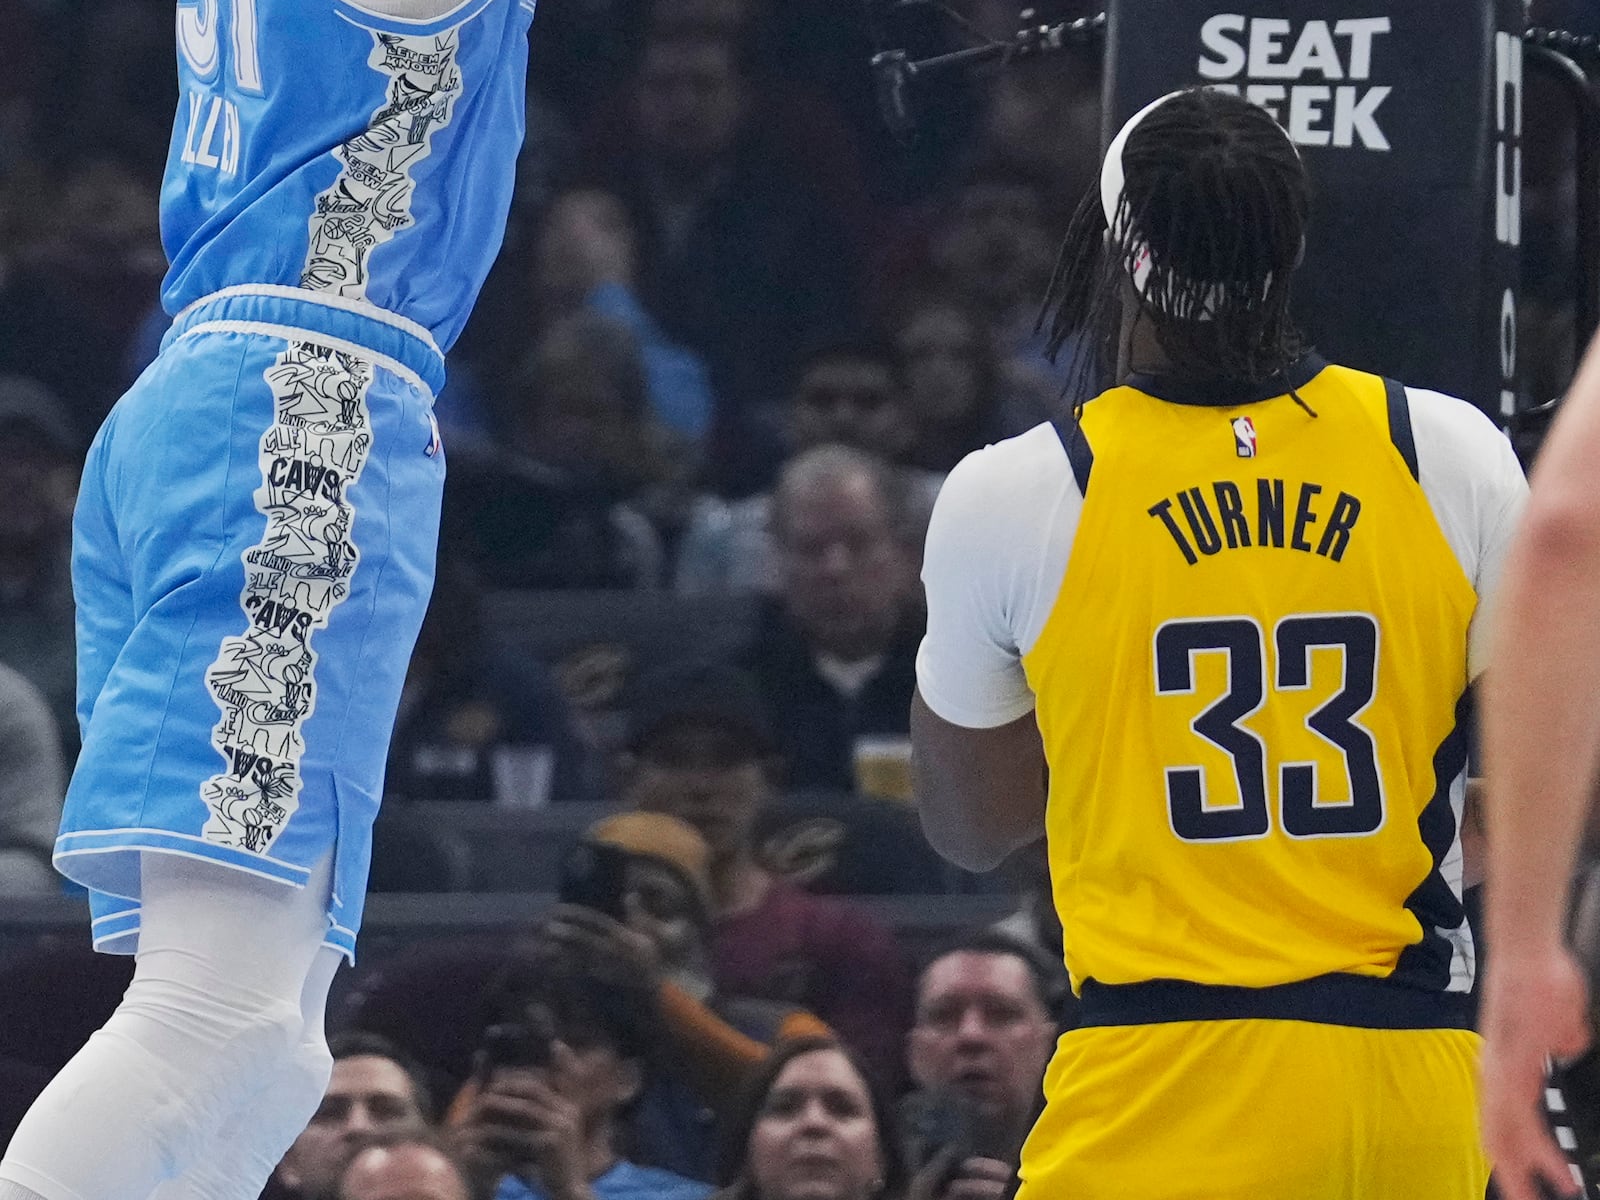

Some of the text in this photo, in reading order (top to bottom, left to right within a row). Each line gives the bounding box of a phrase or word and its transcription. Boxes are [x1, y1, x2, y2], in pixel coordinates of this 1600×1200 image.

[385, 55, 439, 75] KNOW
[1198, 13, 1391, 80] SEAT
[1203, 84, 1392, 151] EEK
[270, 457, 341, 502] CAVS
[1148, 479, 1361, 566] TURNER
[1153, 611, 1387, 842] 33
